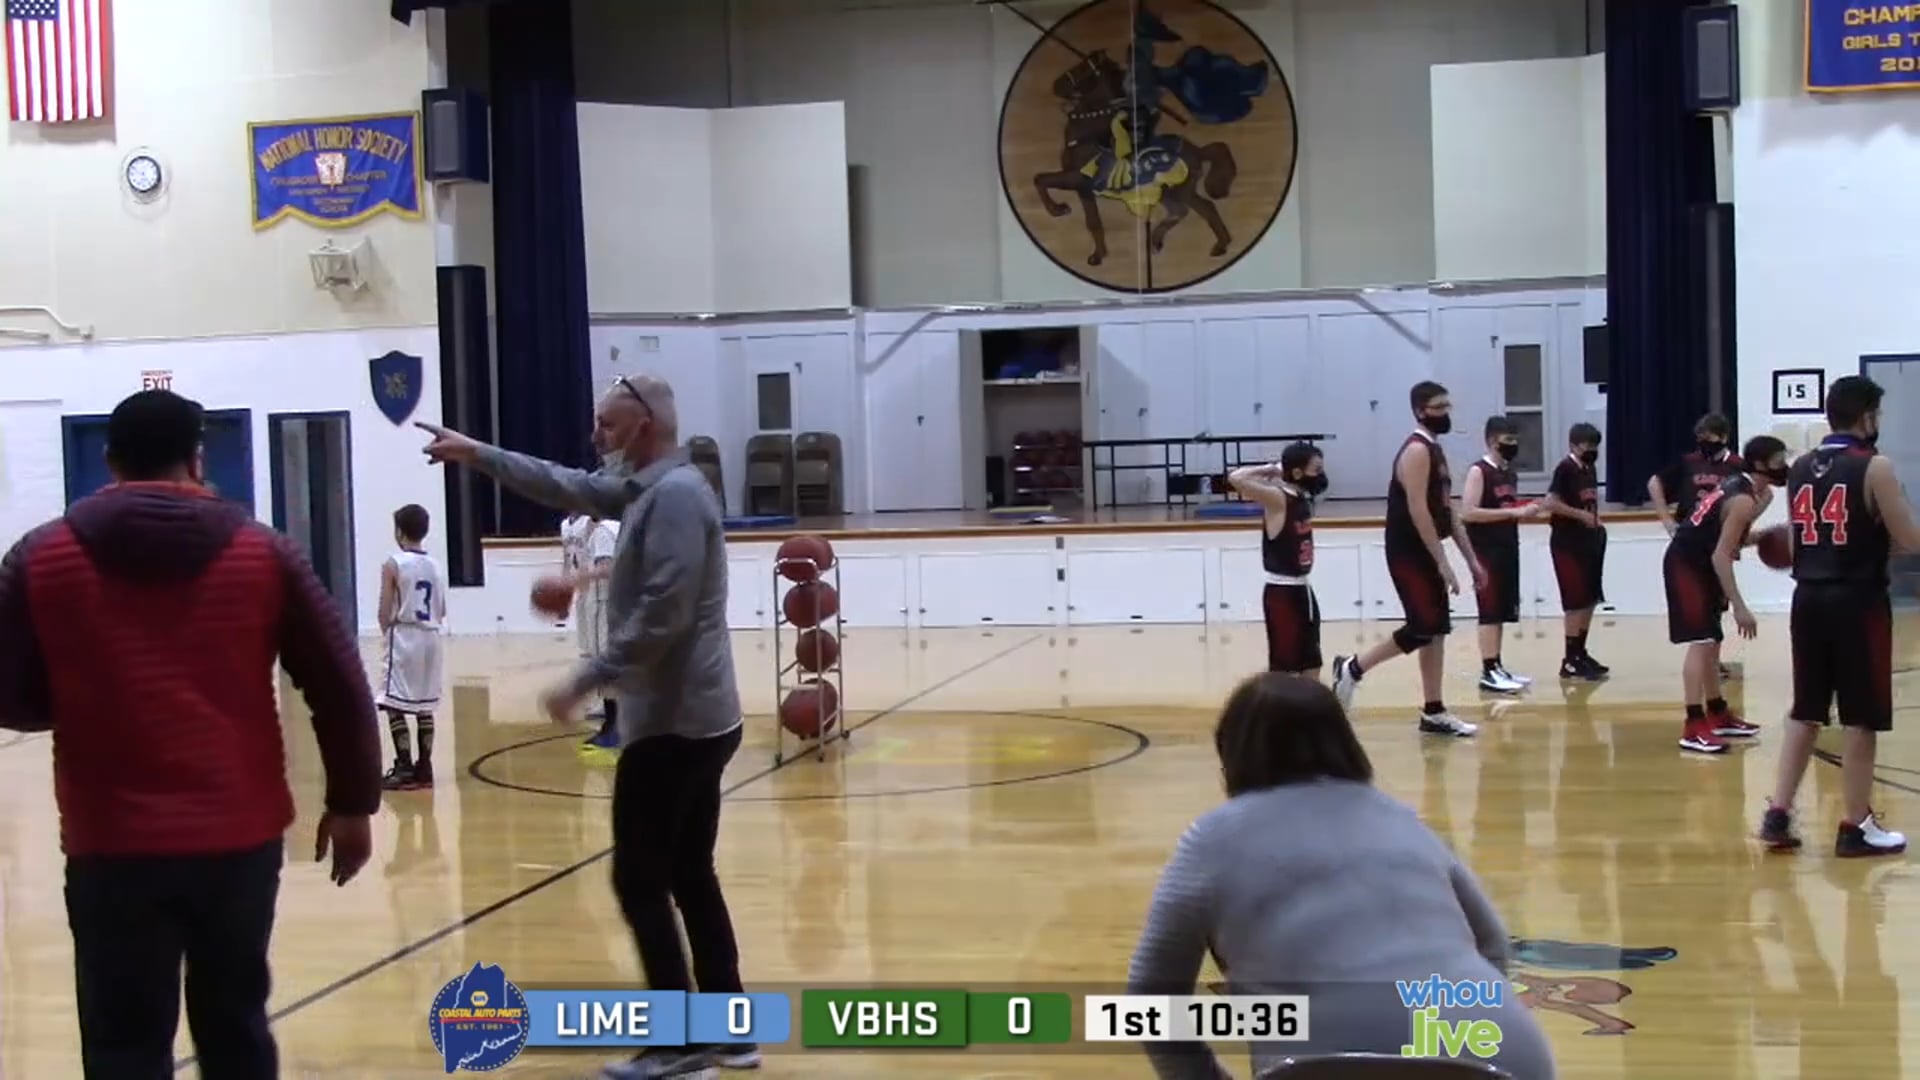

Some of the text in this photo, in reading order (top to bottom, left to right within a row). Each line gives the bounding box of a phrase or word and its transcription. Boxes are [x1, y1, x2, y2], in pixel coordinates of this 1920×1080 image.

[1842, 32, 1902, 50] GIRLS
[258, 126, 408, 172] NATIONAL HONOR SOCIETY
[143, 375, 172, 391] EXIT
[1791, 484, 1848, 545] 44
[414, 580, 432, 621] 3
